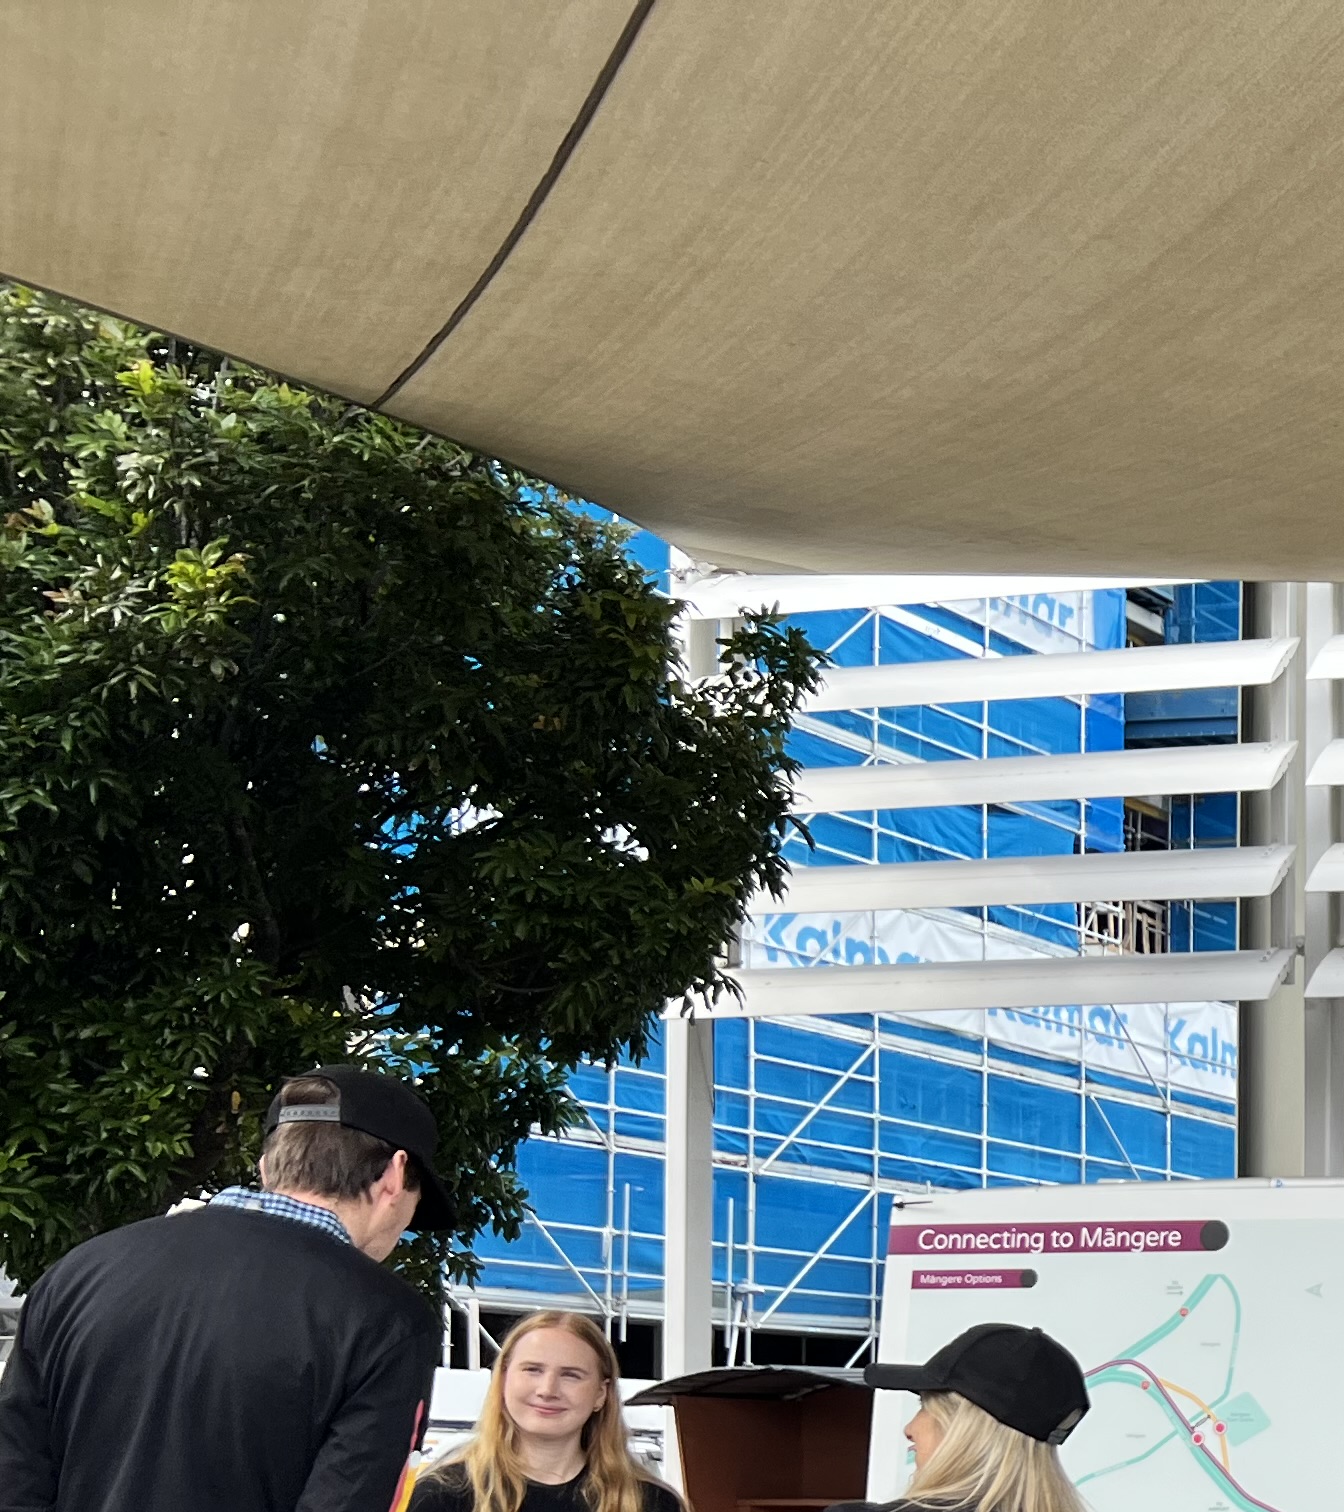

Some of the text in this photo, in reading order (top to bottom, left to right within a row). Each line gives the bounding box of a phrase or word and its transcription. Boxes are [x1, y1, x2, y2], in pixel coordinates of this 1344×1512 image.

[918, 1227, 1182, 1254] Connecting to Māngere
[920, 1273, 1002, 1286] Māngere Options
